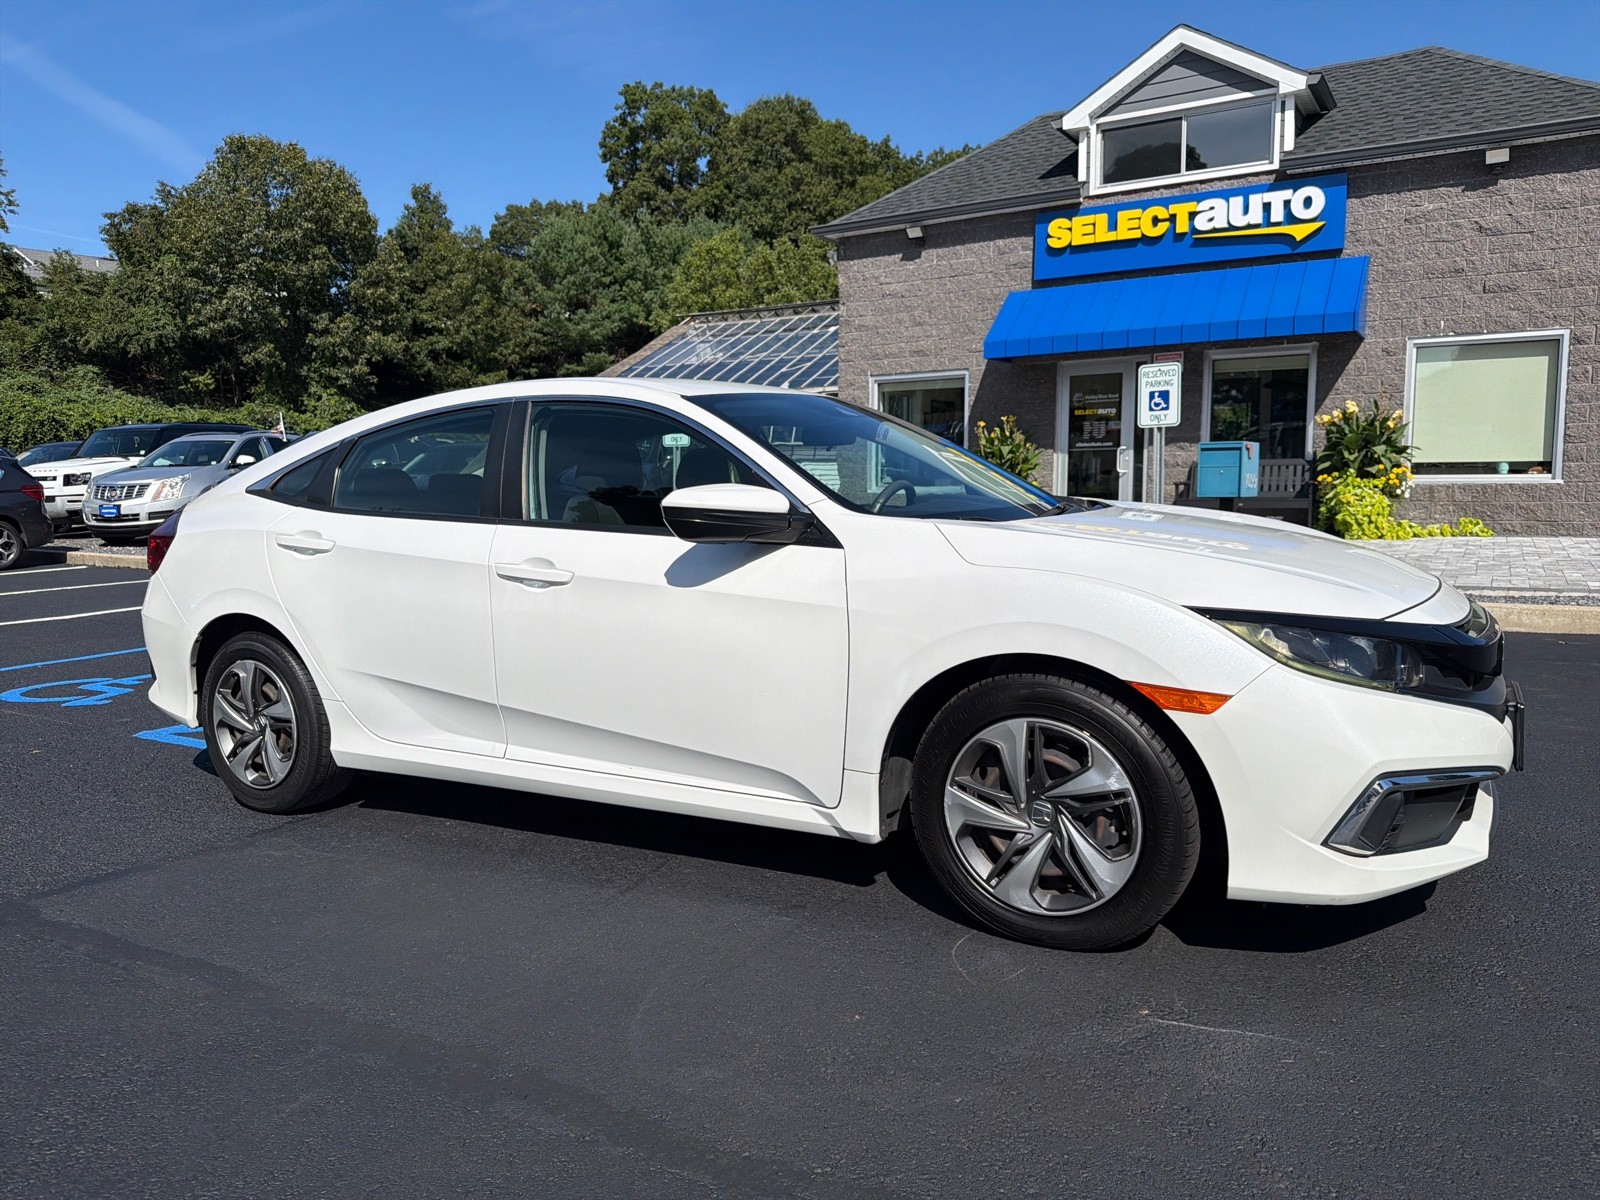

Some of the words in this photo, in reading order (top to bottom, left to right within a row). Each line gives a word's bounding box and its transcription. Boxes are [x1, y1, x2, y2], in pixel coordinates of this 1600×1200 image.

[1142, 368, 1177, 379] RESERVED
[1145, 379, 1174, 389] PARKING
[1149, 413, 1168, 422] ONLY
